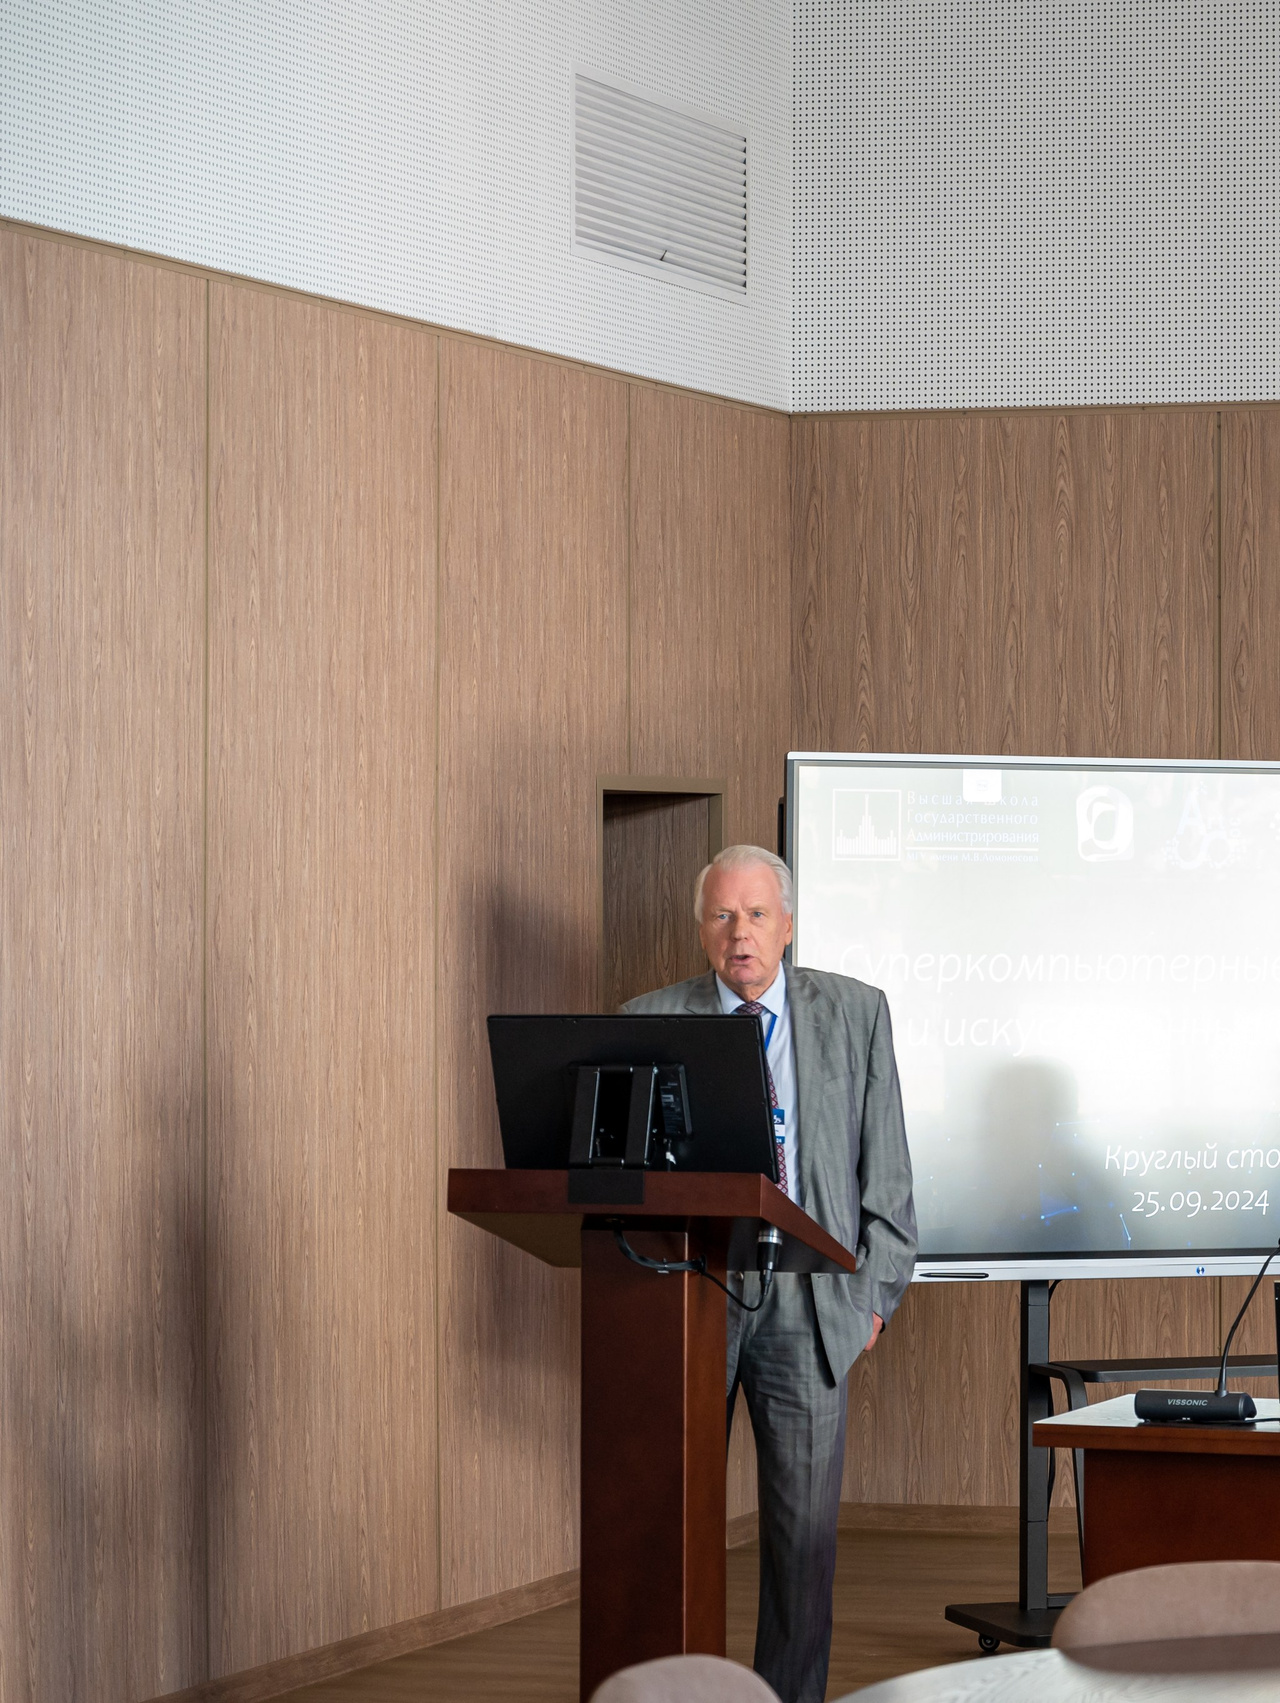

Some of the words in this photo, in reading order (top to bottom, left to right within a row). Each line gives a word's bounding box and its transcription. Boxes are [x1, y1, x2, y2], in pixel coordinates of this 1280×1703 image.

[906, 807, 1039, 828] Государственного
[905, 828, 1039, 847] Администрирования
[1104, 1142, 1218, 1177] Круглый
[1131, 1190, 1270, 1218] 25.09.2024
[1167, 1399, 1208, 1407] VISSONIC
